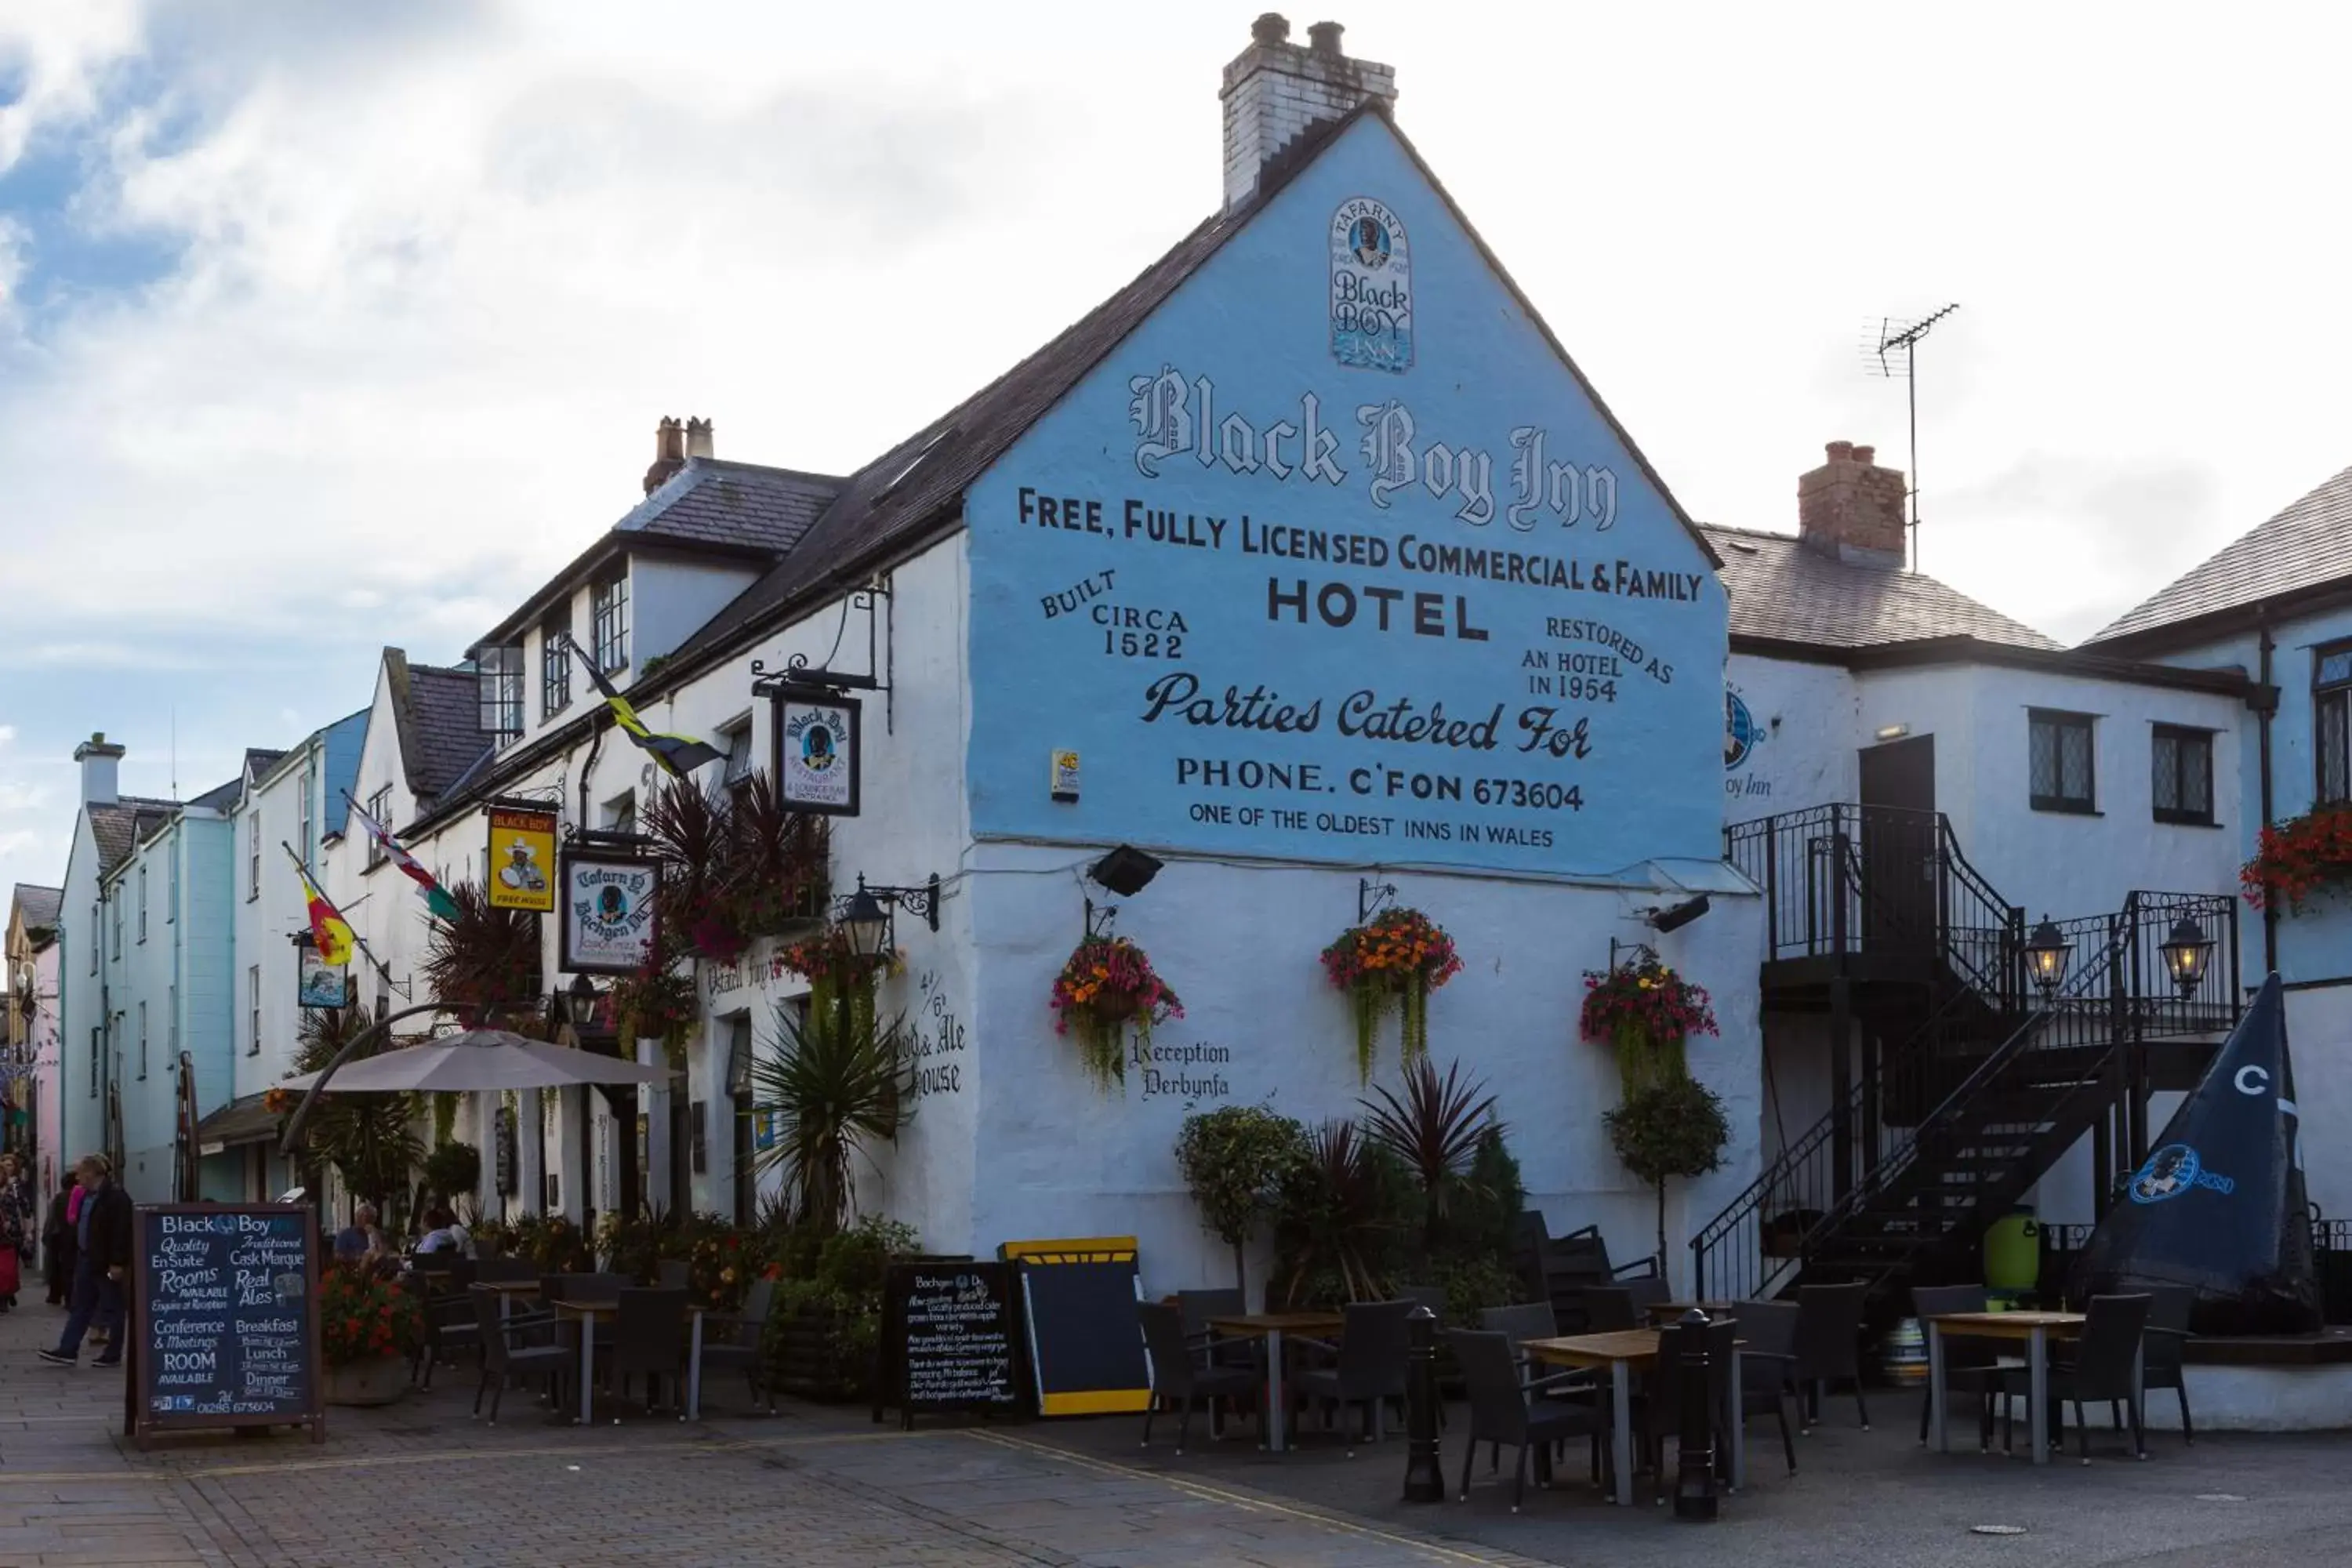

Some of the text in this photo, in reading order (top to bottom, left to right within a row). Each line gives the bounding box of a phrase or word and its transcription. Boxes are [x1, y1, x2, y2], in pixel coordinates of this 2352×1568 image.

[1336, 201, 1396, 234] TAFARN
[1334, 270, 1410, 309] Black
[1335, 303, 1407, 339] BOY
[1353, 336, 1396, 361] INN
[1129, 363, 1617, 532] Black Boy Inn
[1018, 487, 1114, 539] FREE,
[1124, 499, 1228, 549] FULLY
[1242, 515, 1389, 568] LICENSED
[1398, 534, 1584, 590] COMMERCIAL
[1616, 561, 1702, 602] FAMILY
[1040, 569, 1116, 619] BUILT
[1092, 604, 1189, 633] CIRCA
[1268, 577, 1489, 641] HOTEL
[1105, 630, 1182, 659] 1522
[1546, 617, 1674, 685] RESTORED AS
[1521, 649, 1623, 678] AN HOTEL
[1530, 674, 1617, 703] IN 1954
[1141, 673, 1592, 759] Parties Catered For
[1178, 757, 1336, 793] PHONE.
[1473, 778, 1584, 812] 673604
[1726, 772, 1772, 800] oy Inn
[493, 815, 550, 832] BLACK BOY
[1189, 803, 1553, 848] ONE OF THE OLDEST INNS IN WALES
[575, 867, 628, 888] Tafarn
[920, 1034, 932, 1056] &
[937, 1014, 966, 1054] Ale
[1129, 1035, 1229, 1069] Reception
[1142, 1069, 1229, 1102] Derbynfa
[162, 1216, 216, 1233] Black
[238, 1215, 271, 1236] Boy
[161, 1236, 210, 1255] Quality
[230, 1249, 306, 1270] Cask Marque
[160, 1267, 219, 1294] Rooms
[234, 1267, 270, 1292] Real
[238, 1288, 274, 1308] Ales
[154, 1318, 225, 1335] Conference
[235, 1318, 299, 1334] Breakfast
[162, 1352, 217, 1371] ROOM
[245, 1346, 287, 1360] Lunch
[158, 1372, 214, 1386] AVAILABLE
[245, 1371, 290, 1386] Dinner
